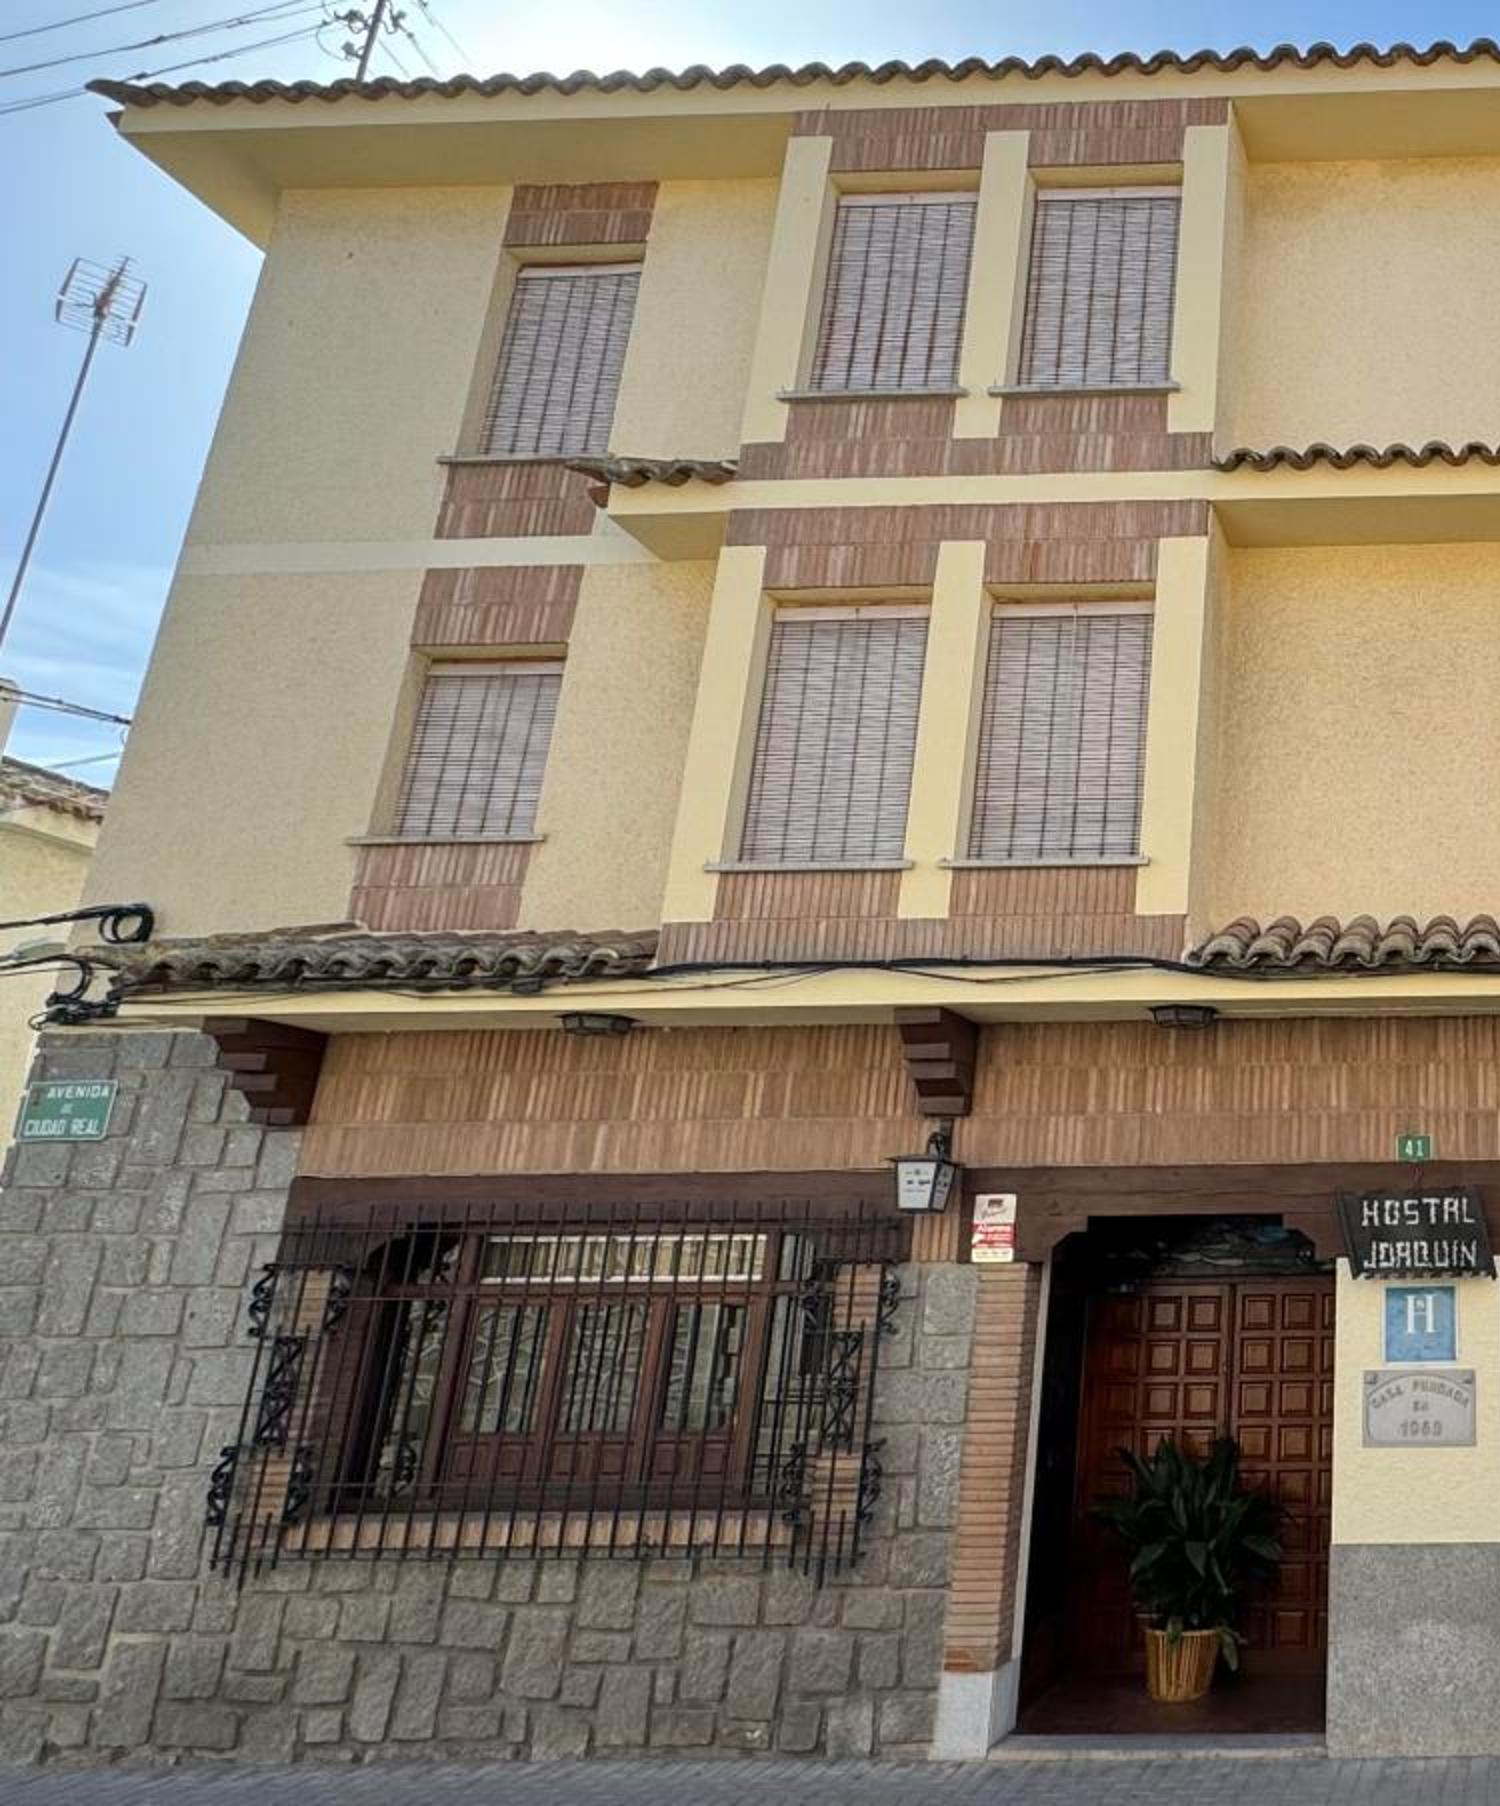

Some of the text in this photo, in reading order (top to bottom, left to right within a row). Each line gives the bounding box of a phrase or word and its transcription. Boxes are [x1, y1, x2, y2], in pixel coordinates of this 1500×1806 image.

[47, 1085, 111, 1099] AVENIDA
[23, 1118, 100, 1136] CIUDAD REAL
[1405, 1139, 1424, 1157] 41
[1361, 1197, 1475, 1227] HOSTAL
[1362, 1239, 1478, 1269] JOAQUIN
